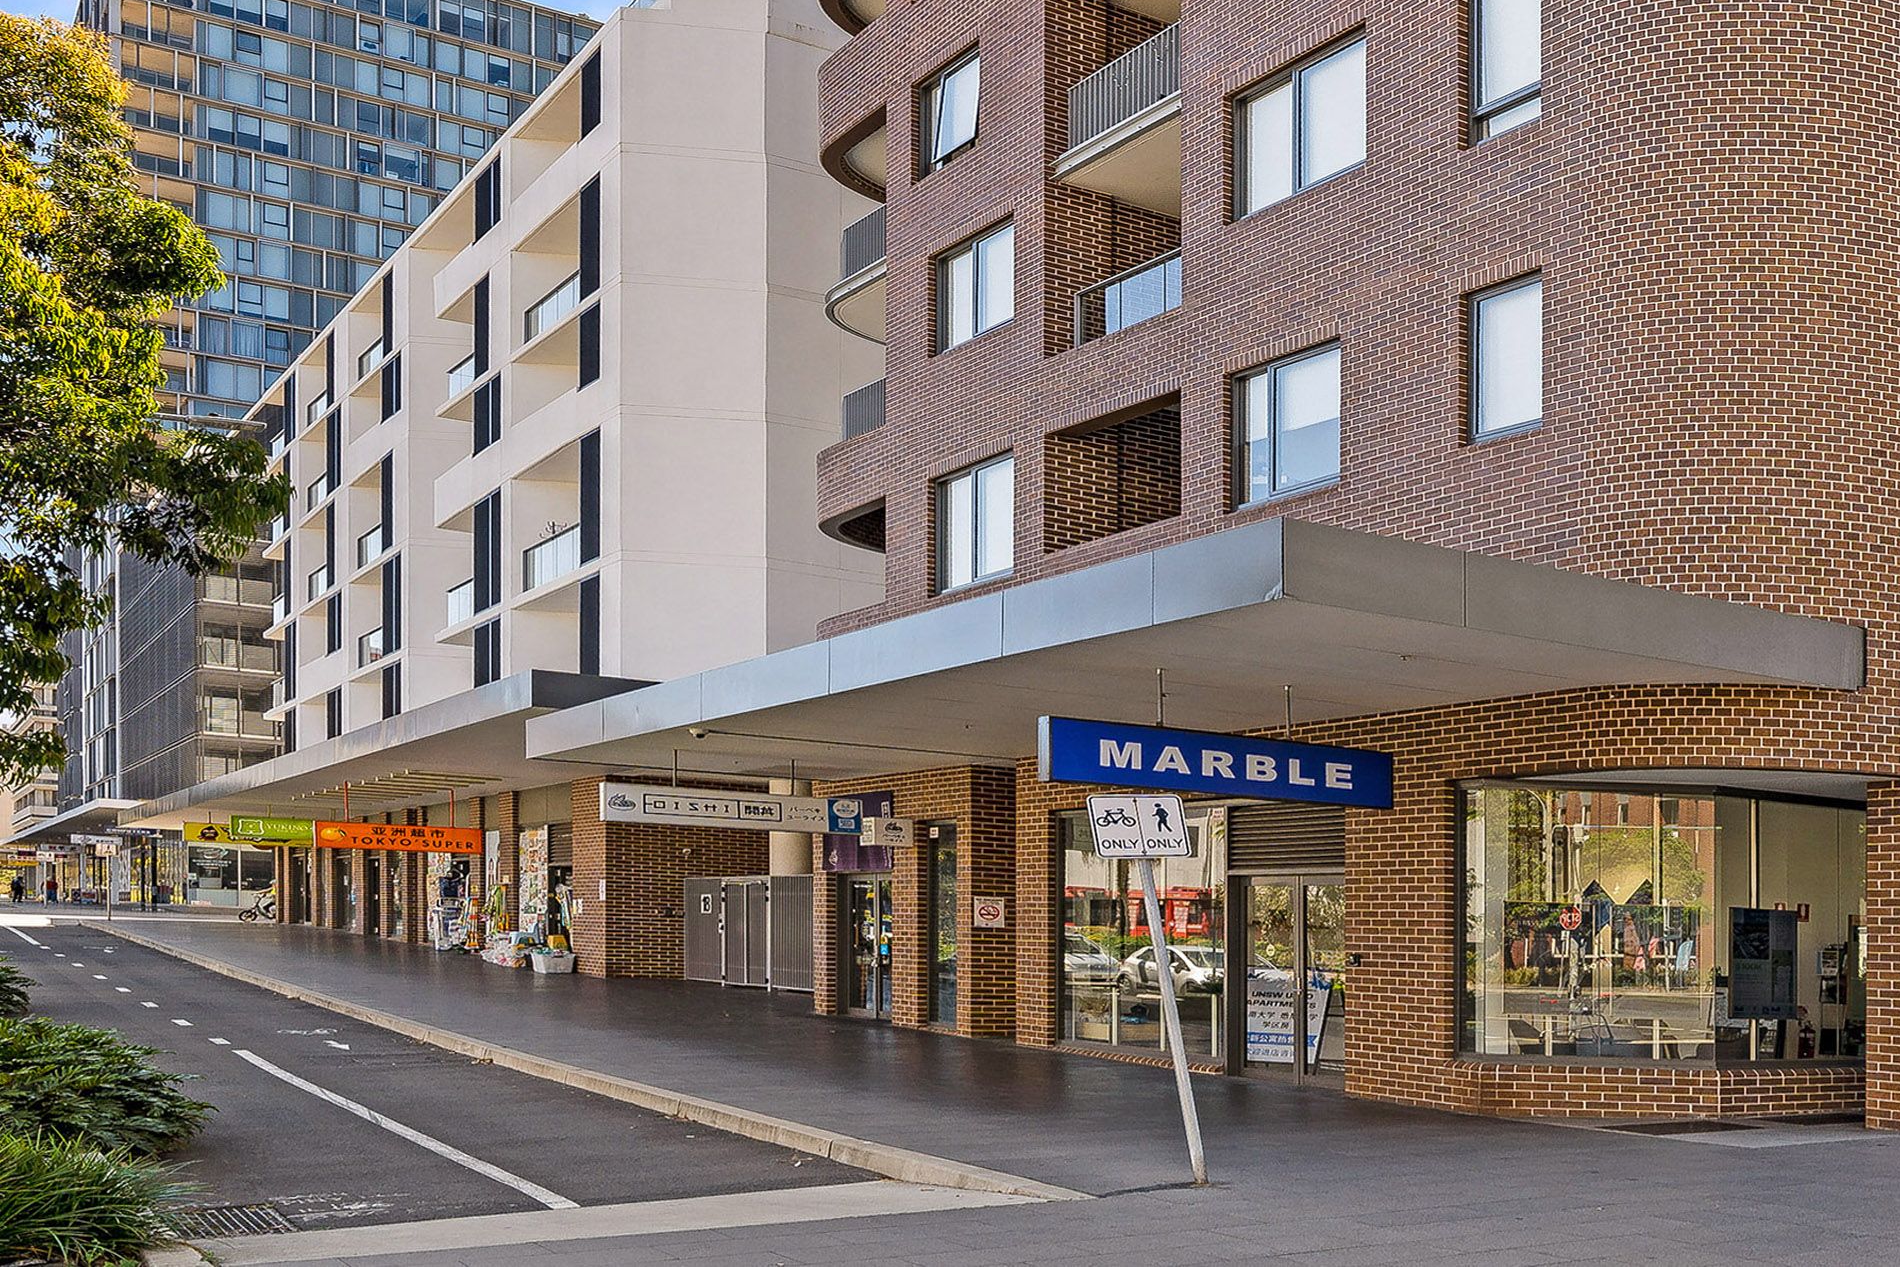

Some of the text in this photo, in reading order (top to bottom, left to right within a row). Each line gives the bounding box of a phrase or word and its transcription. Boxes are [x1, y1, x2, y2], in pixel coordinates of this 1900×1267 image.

[1099, 738, 1353, 790] MARBLE
[371, 826, 445, 838] 亚洲超市
[1101, 838, 1138, 850] ONLY
[1147, 838, 1183, 850] ONLY
[1251, 990, 1283, 998] UNSW
